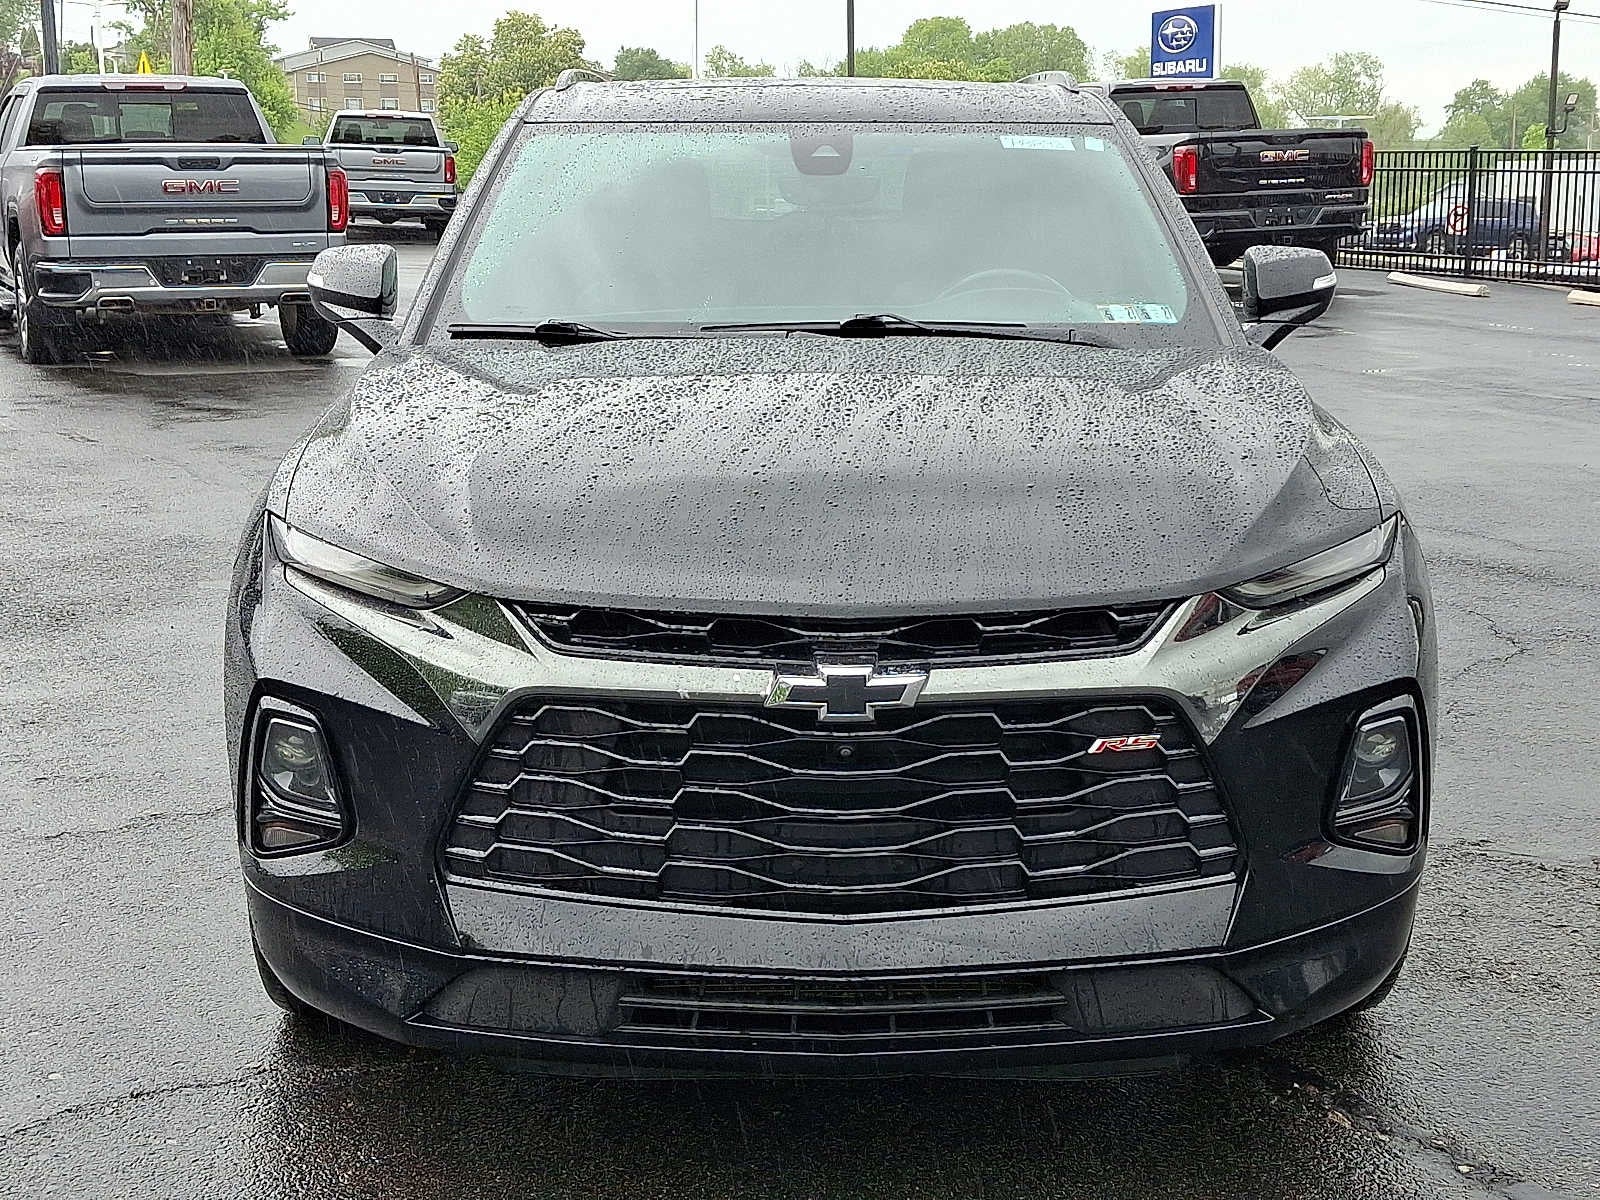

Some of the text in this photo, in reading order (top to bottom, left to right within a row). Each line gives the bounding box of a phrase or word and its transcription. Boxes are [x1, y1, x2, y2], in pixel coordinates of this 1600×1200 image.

[1152, 58, 1207, 76] SUBARU
[372, 156, 407, 166] GMC
[1260, 149, 1309, 162] GMC
[162, 179, 240, 194] GMC
[1087, 734, 1161, 754] RS
